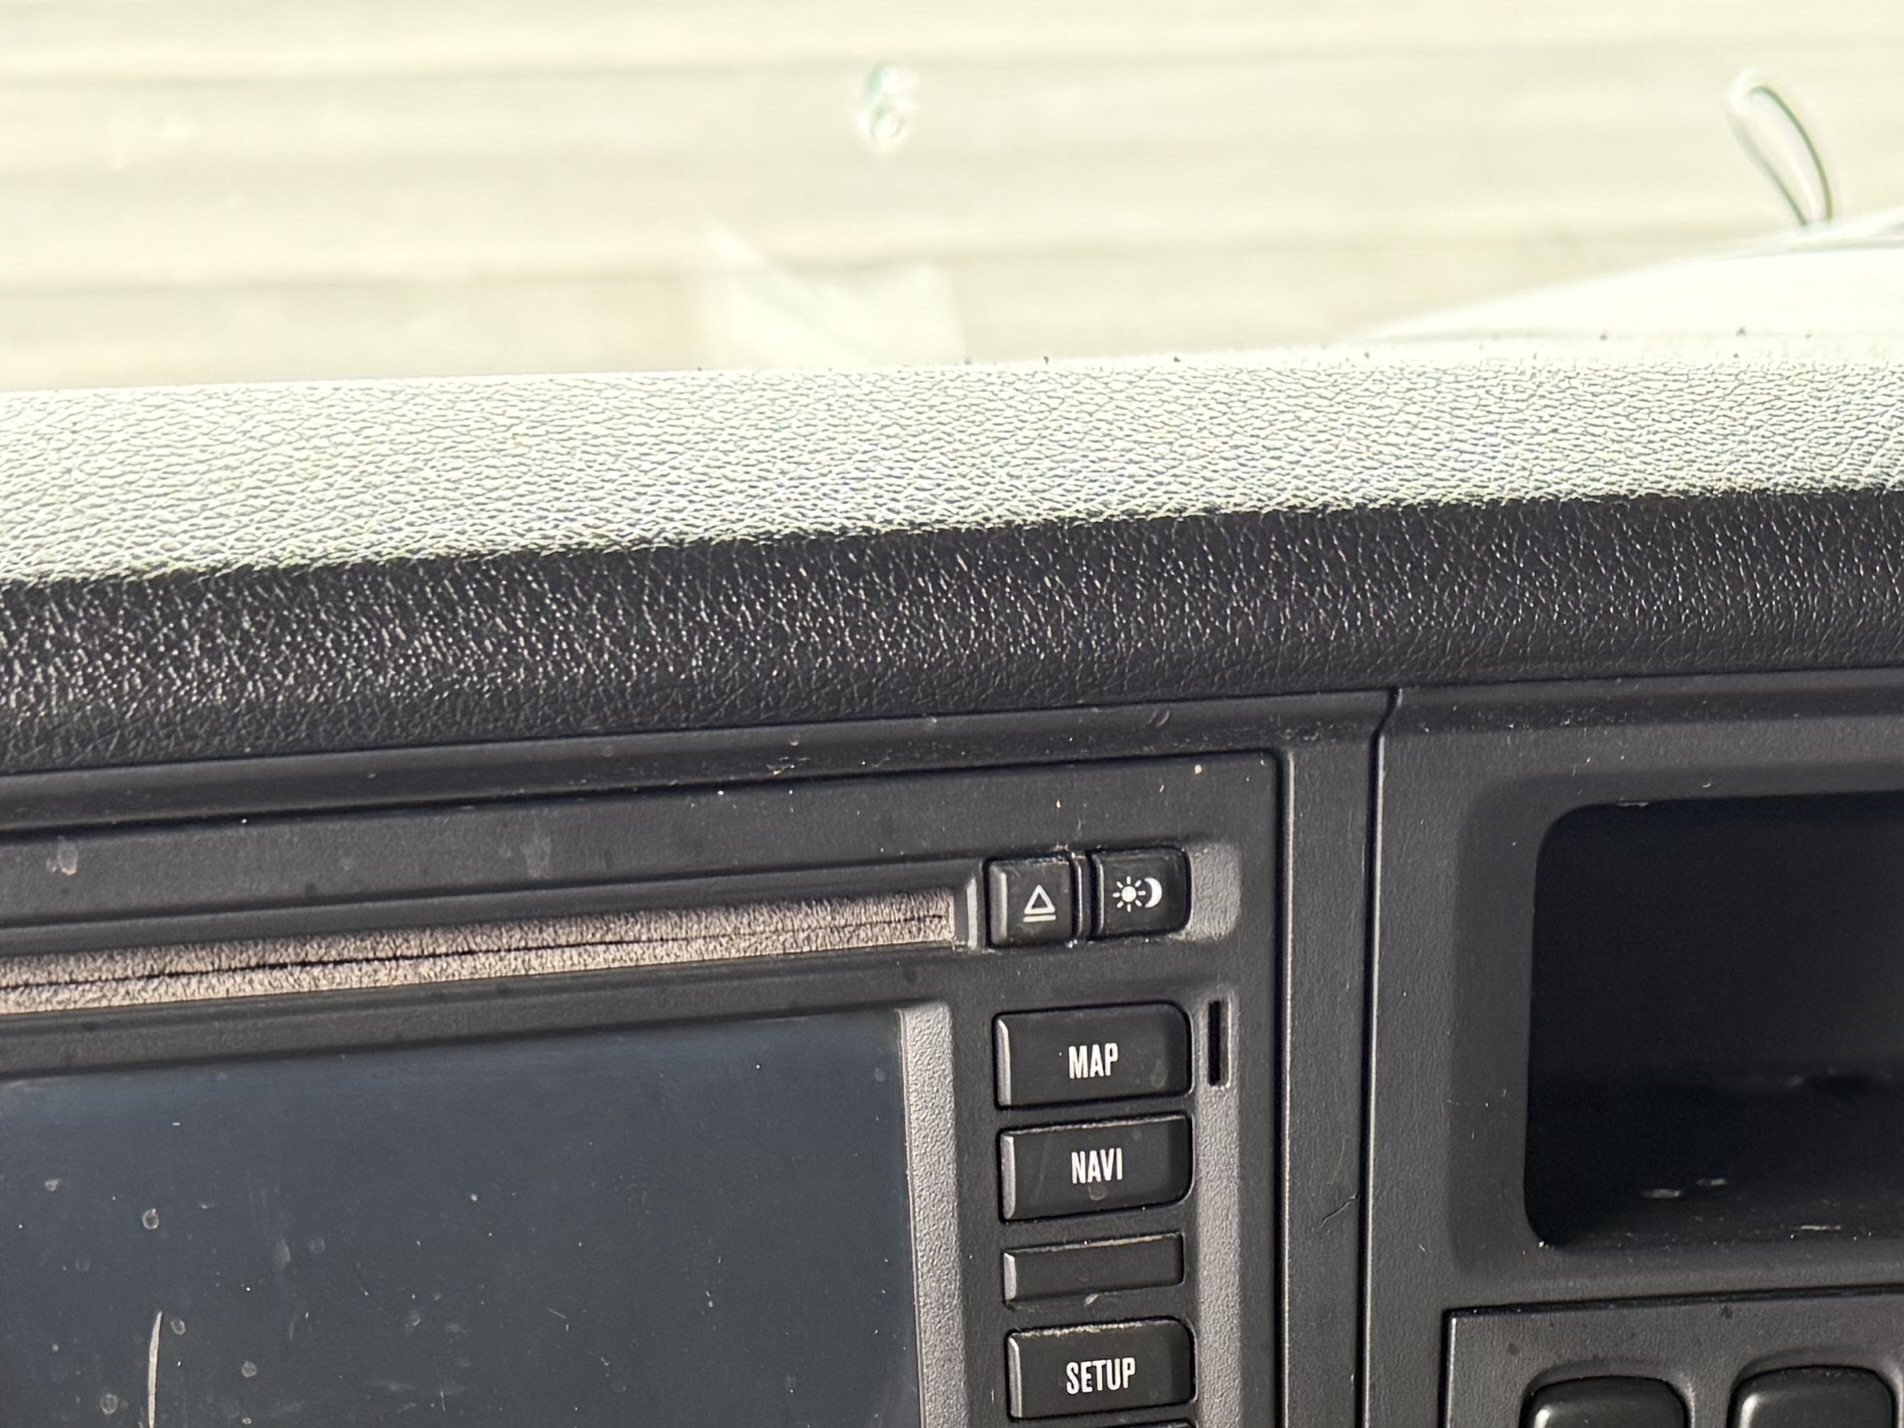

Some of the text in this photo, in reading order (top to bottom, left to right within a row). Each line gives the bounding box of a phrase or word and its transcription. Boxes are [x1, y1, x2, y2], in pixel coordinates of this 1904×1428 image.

[1068, 1042, 1119, 1079] MAP
[1071, 1147, 1123, 1184] NAVI
[1066, 1357, 1136, 1395] SETUP
